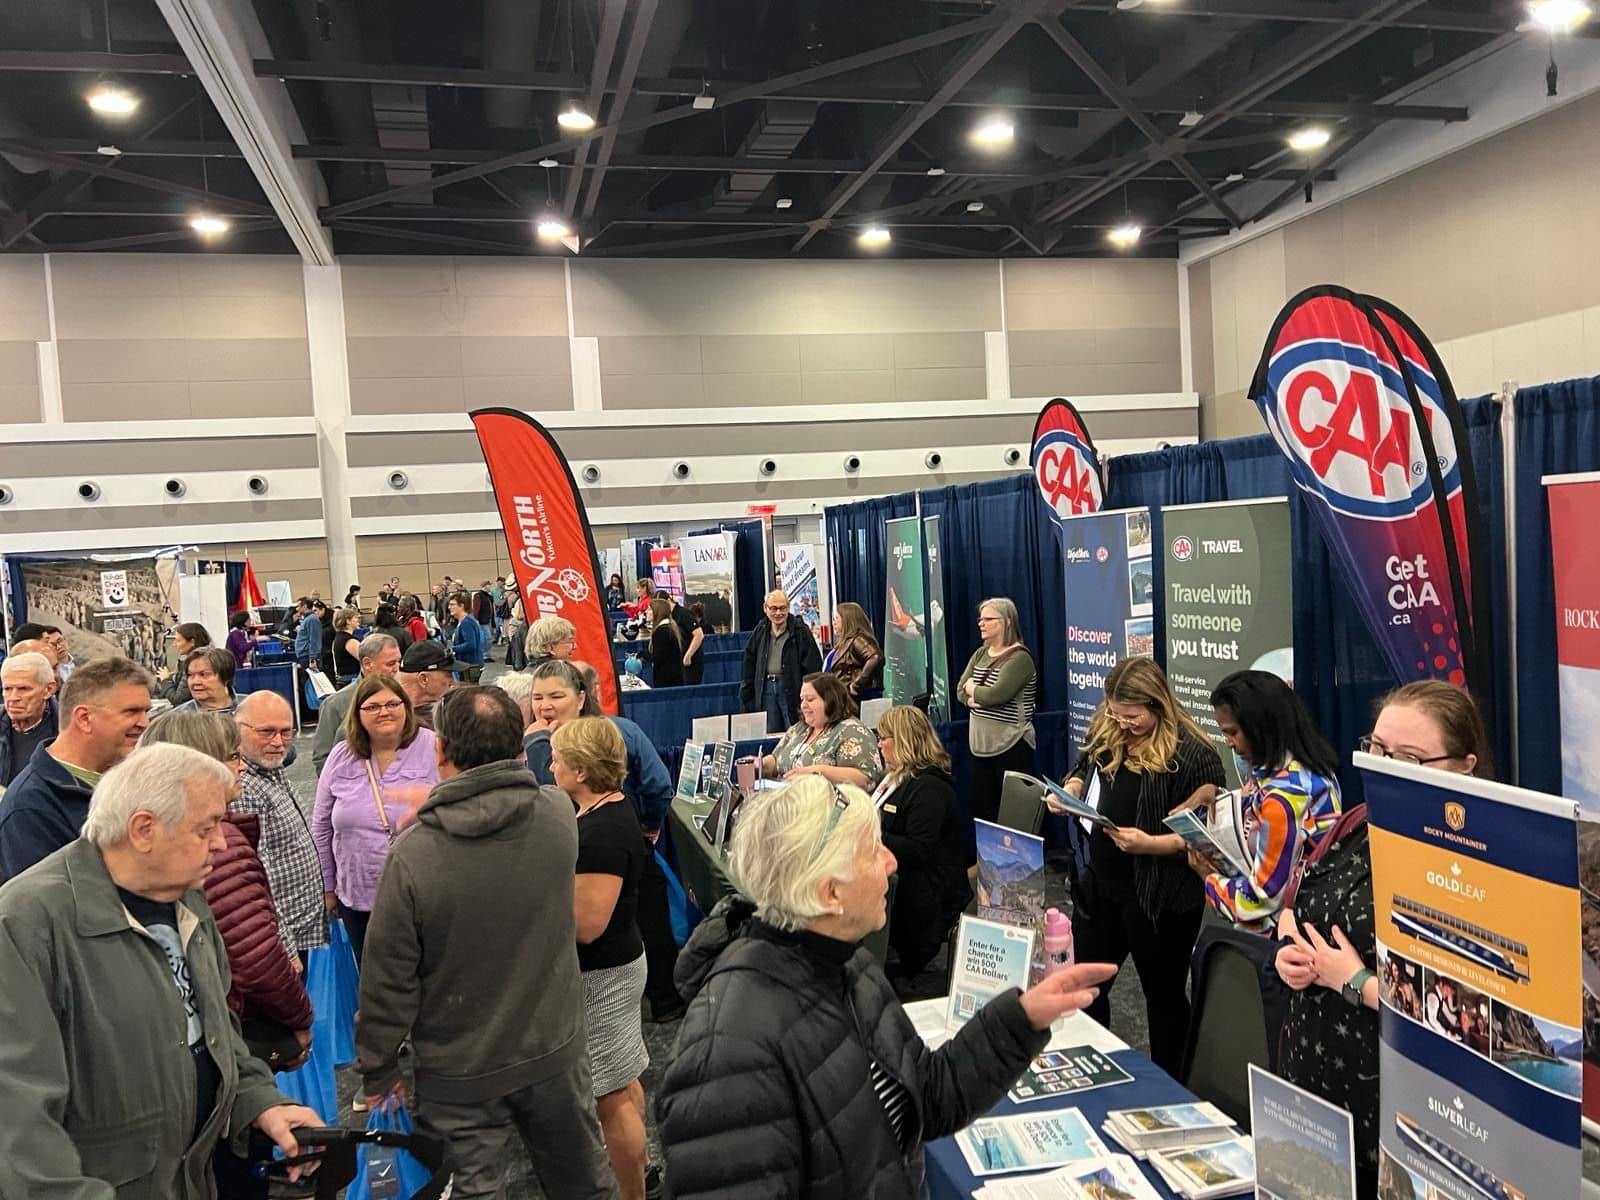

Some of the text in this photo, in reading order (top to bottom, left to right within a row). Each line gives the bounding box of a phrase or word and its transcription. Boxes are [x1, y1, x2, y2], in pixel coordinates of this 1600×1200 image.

[1286, 370, 1411, 497] CAA
[1040, 447, 1096, 514] CAA
[513, 496, 563, 610] NORTH
[1202, 540, 1244, 554] TRAVEL
[1385, 554, 1430, 581] Get
[1171, 583, 1252, 606] Travel with
[1387, 581, 1441, 610] CAA
[1171, 612, 1242, 633] someone
[1388, 612, 1412, 626] .ca
[1068, 626, 1112, 645] Discover
[1068, 647, 1117, 668] the world
[1171, 637, 1240, 661] you trust
[1423, 825, 1488, 852] ROCKY MOUNTAINEER
[967, 947, 1004, 963] chance to
[969, 939, 988, 950] Enter
[989, 943, 1000, 953] for
[965, 963, 981, 975] CAA
[981, 968, 1008, 982] Dollars
[1427, 1096, 1489, 1144] SILVERLEAF
